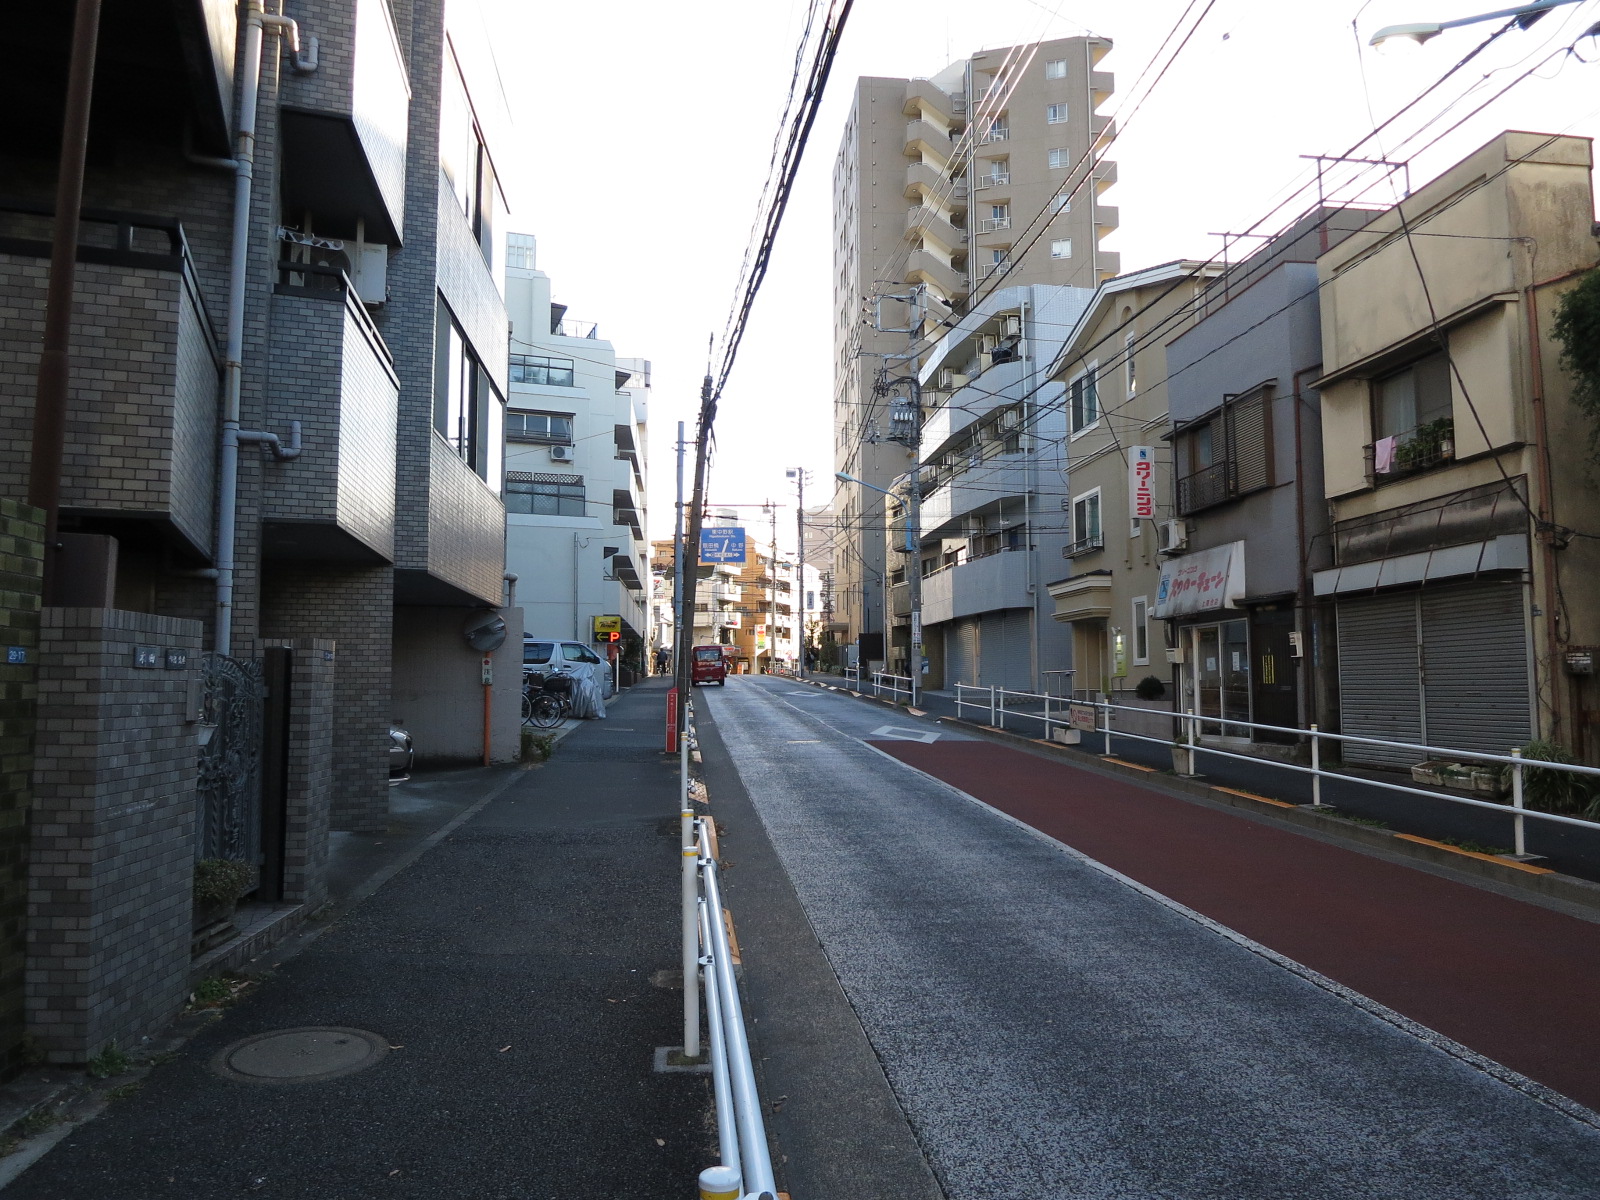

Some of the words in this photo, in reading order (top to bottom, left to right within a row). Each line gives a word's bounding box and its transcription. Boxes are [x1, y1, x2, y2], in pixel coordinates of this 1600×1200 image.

[1136, 461, 1152, 516] クリーニング
[610, 632, 620, 643] P
